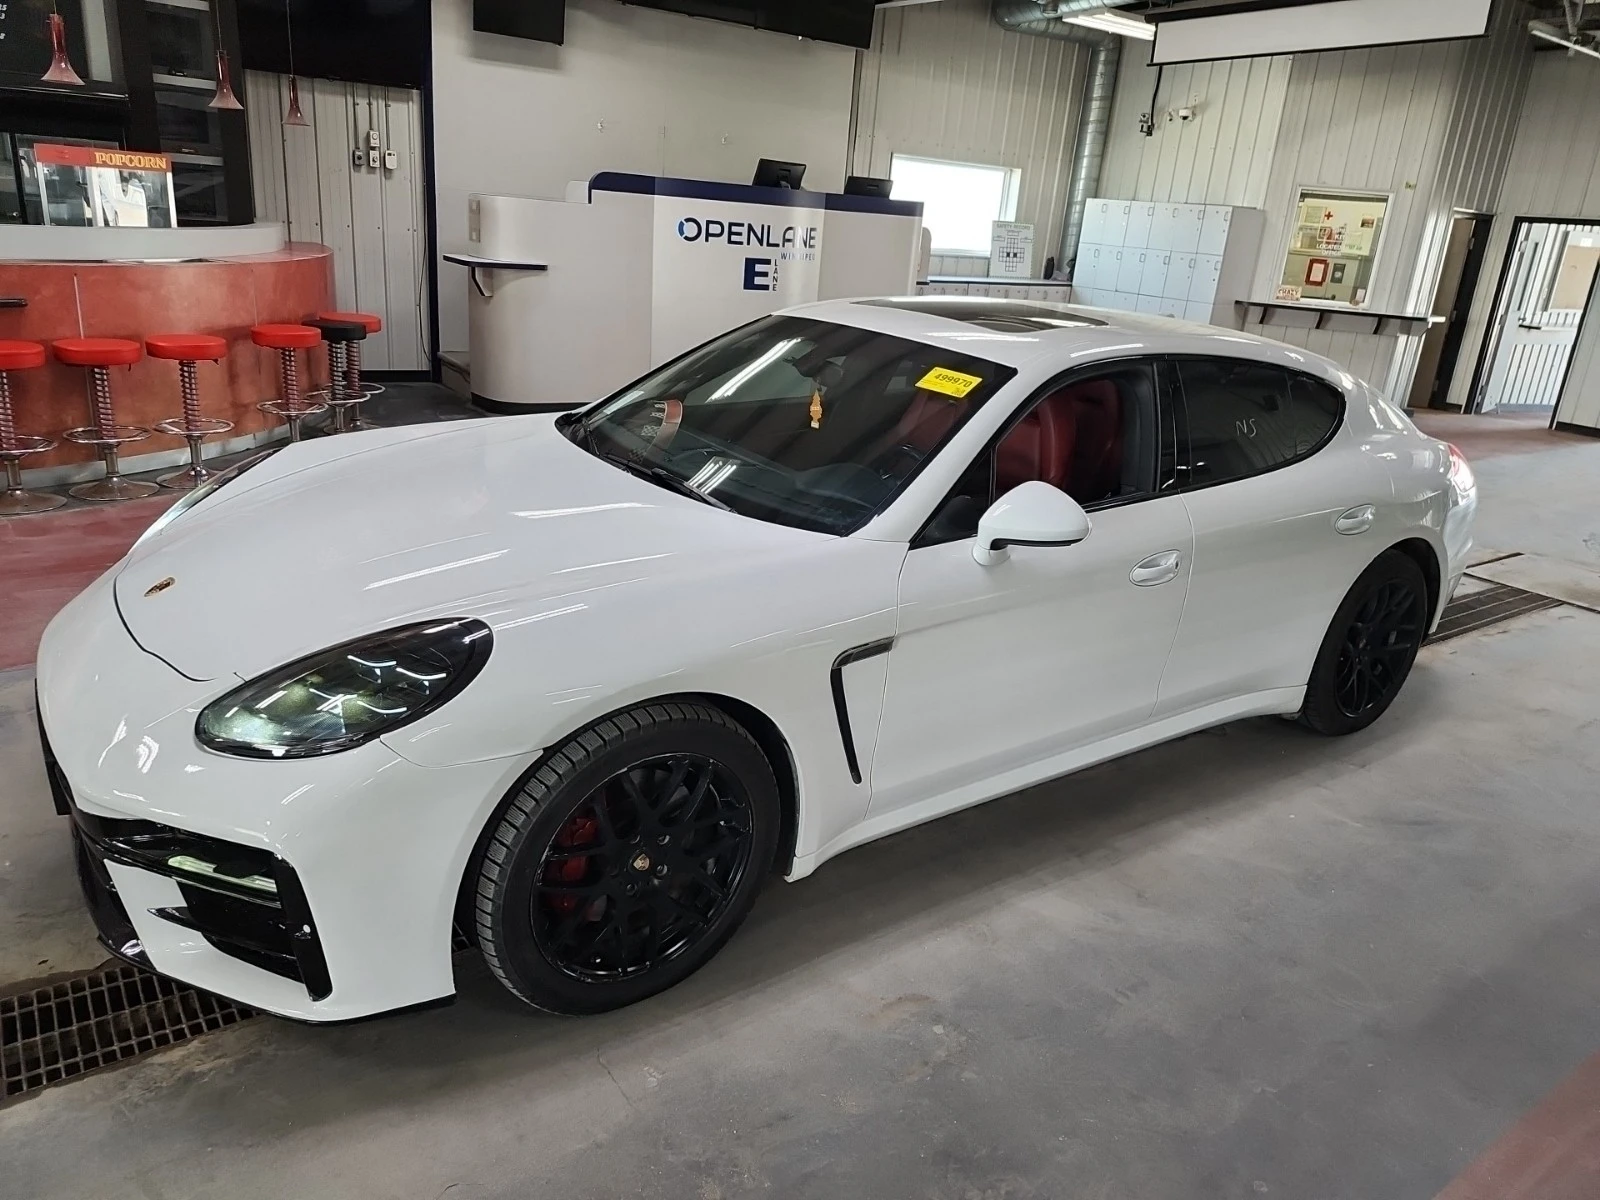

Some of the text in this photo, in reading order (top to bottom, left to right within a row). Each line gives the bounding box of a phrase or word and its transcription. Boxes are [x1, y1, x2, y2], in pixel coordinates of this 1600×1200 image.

[94, 152, 167, 169] POPCORN
[678, 217, 817, 249] OPENLANE
[780, 252, 816, 261] WINIPEG
[743, 257, 772, 292] E
[934, 373, 973, 388] 499970
[1235, 418, 1257, 438] NS
